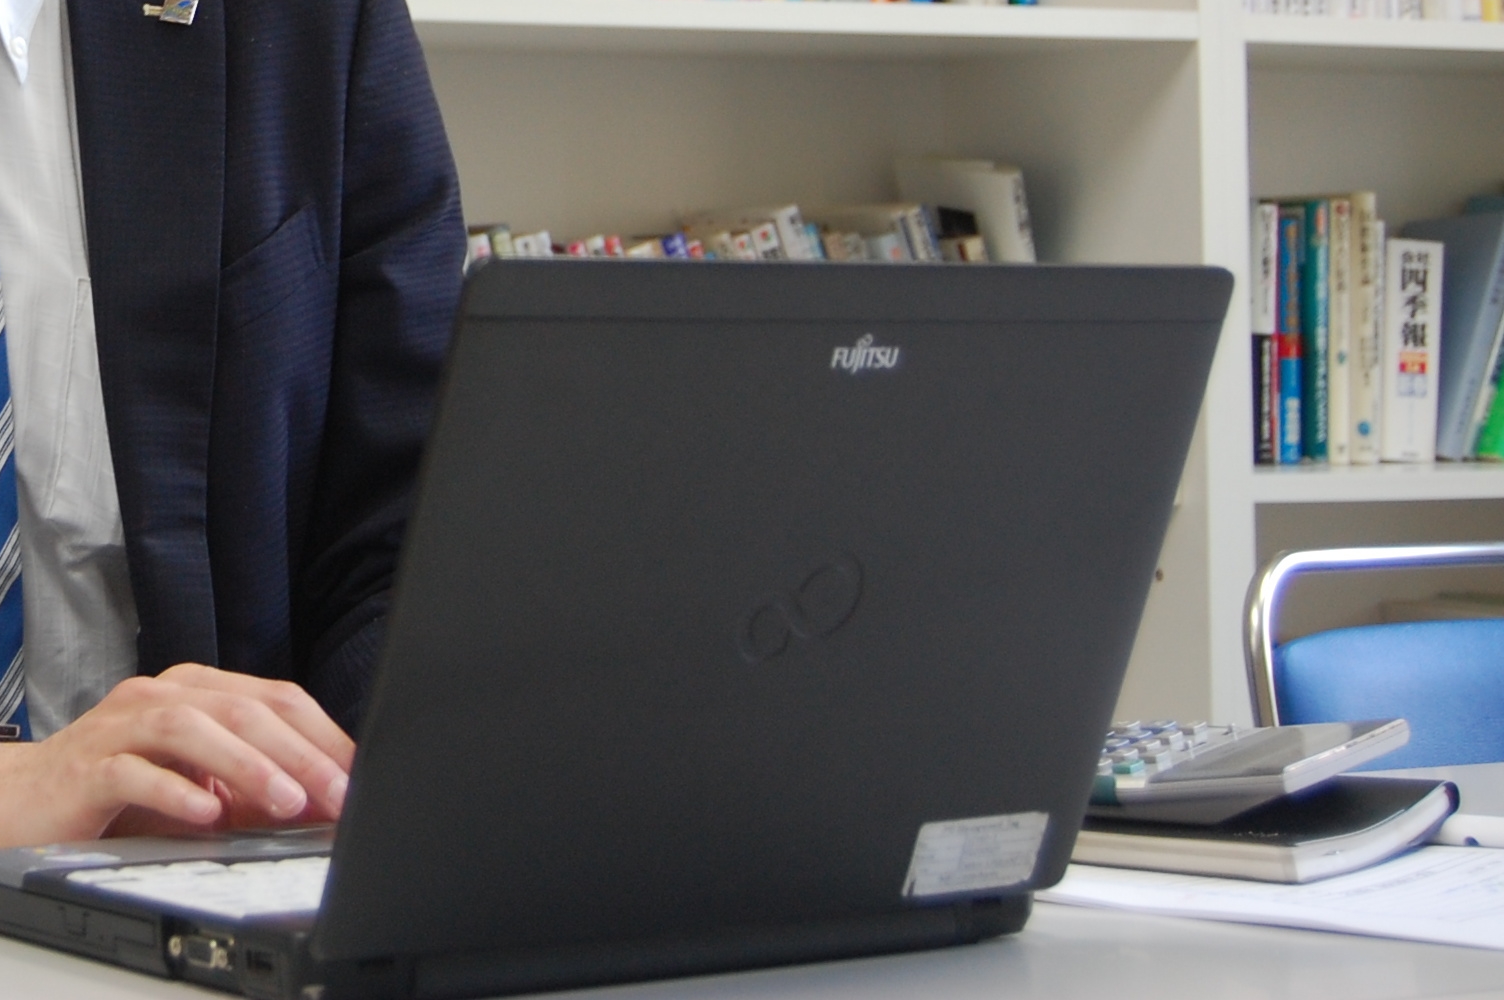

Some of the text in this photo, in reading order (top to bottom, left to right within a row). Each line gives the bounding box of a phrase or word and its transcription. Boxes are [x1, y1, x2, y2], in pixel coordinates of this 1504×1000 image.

[1401, 267, 1429, 349] 四季報
[830, 332, 899, 374] FUJITSU
